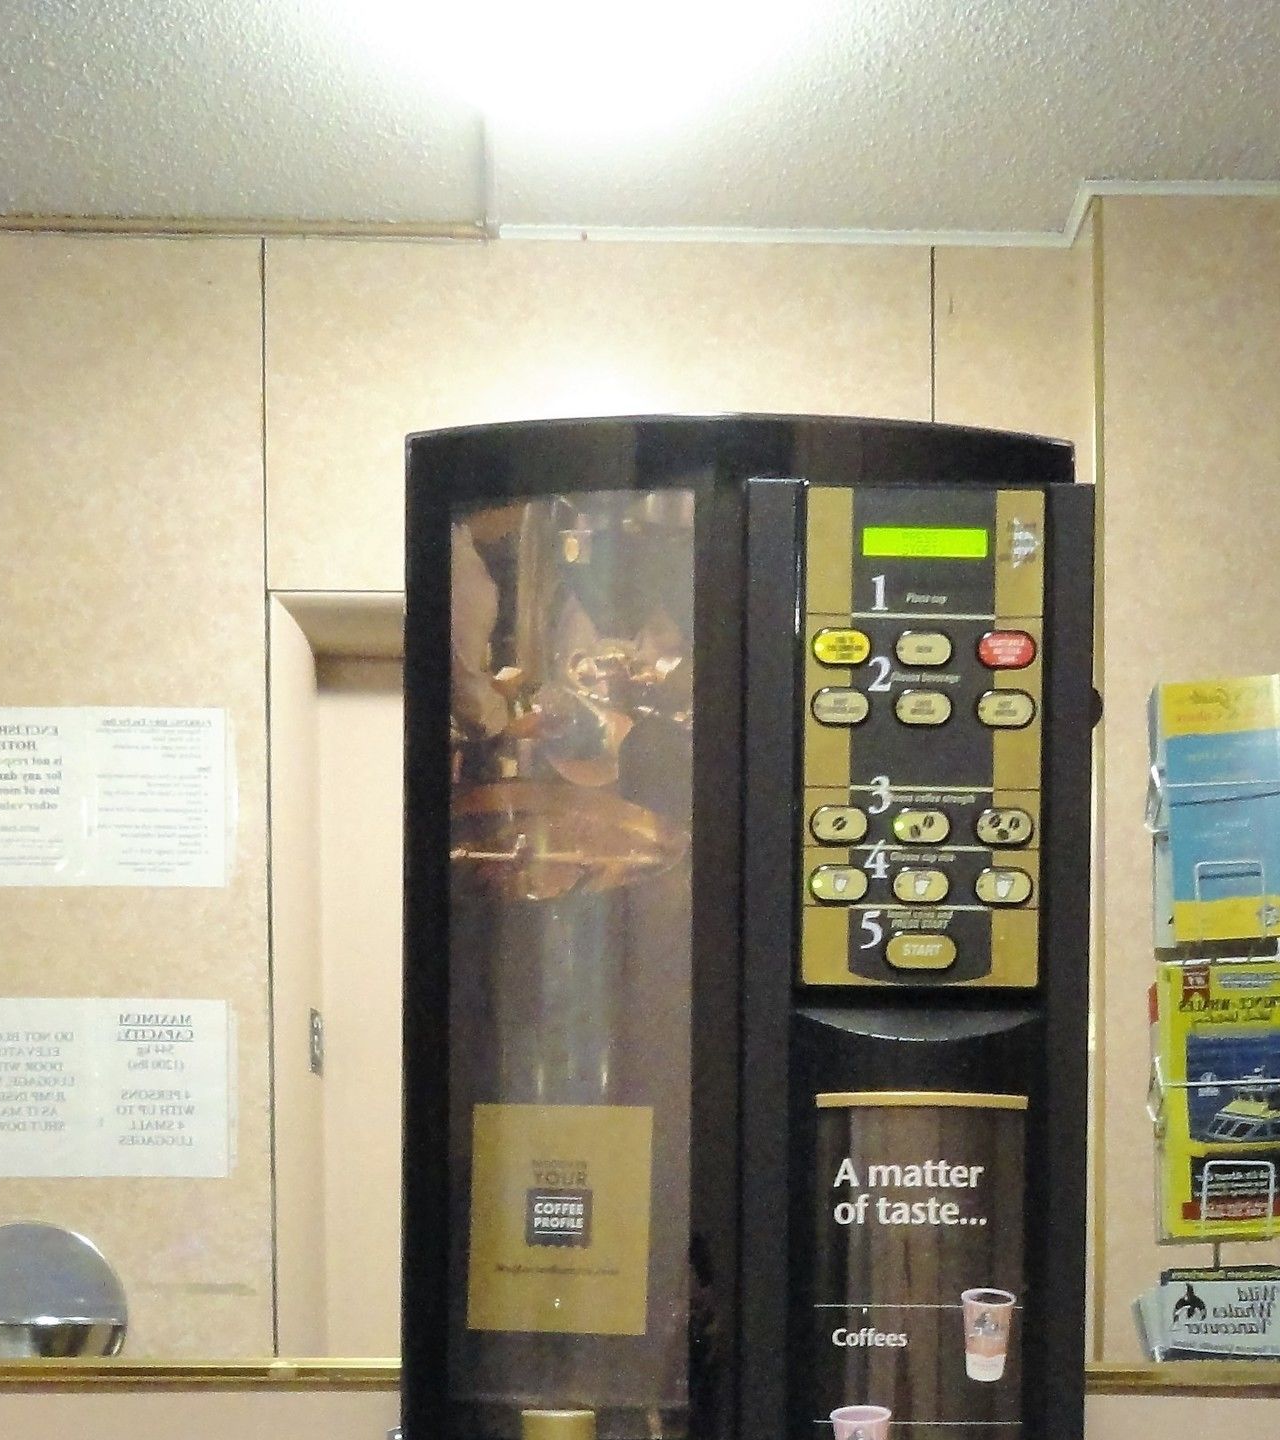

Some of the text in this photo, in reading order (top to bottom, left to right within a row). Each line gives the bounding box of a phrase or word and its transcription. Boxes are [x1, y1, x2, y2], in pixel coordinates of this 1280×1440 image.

[871, 574, 889, 612] 1
[867, 655, 892, 692] 2
[868, 774, 891, 815] 3
[863, 838, 891, 879] 4
[859, 909, 883, 950] 5
[833, 1157, 985, 1188] A matter
[533, 1202, 585, 1216] COFFEE
[533, 1216, 585, 1230] PROFILE
[833, 1194, 988, 1226] of taste...
[831, 1327, 908, 1348] Coffees
